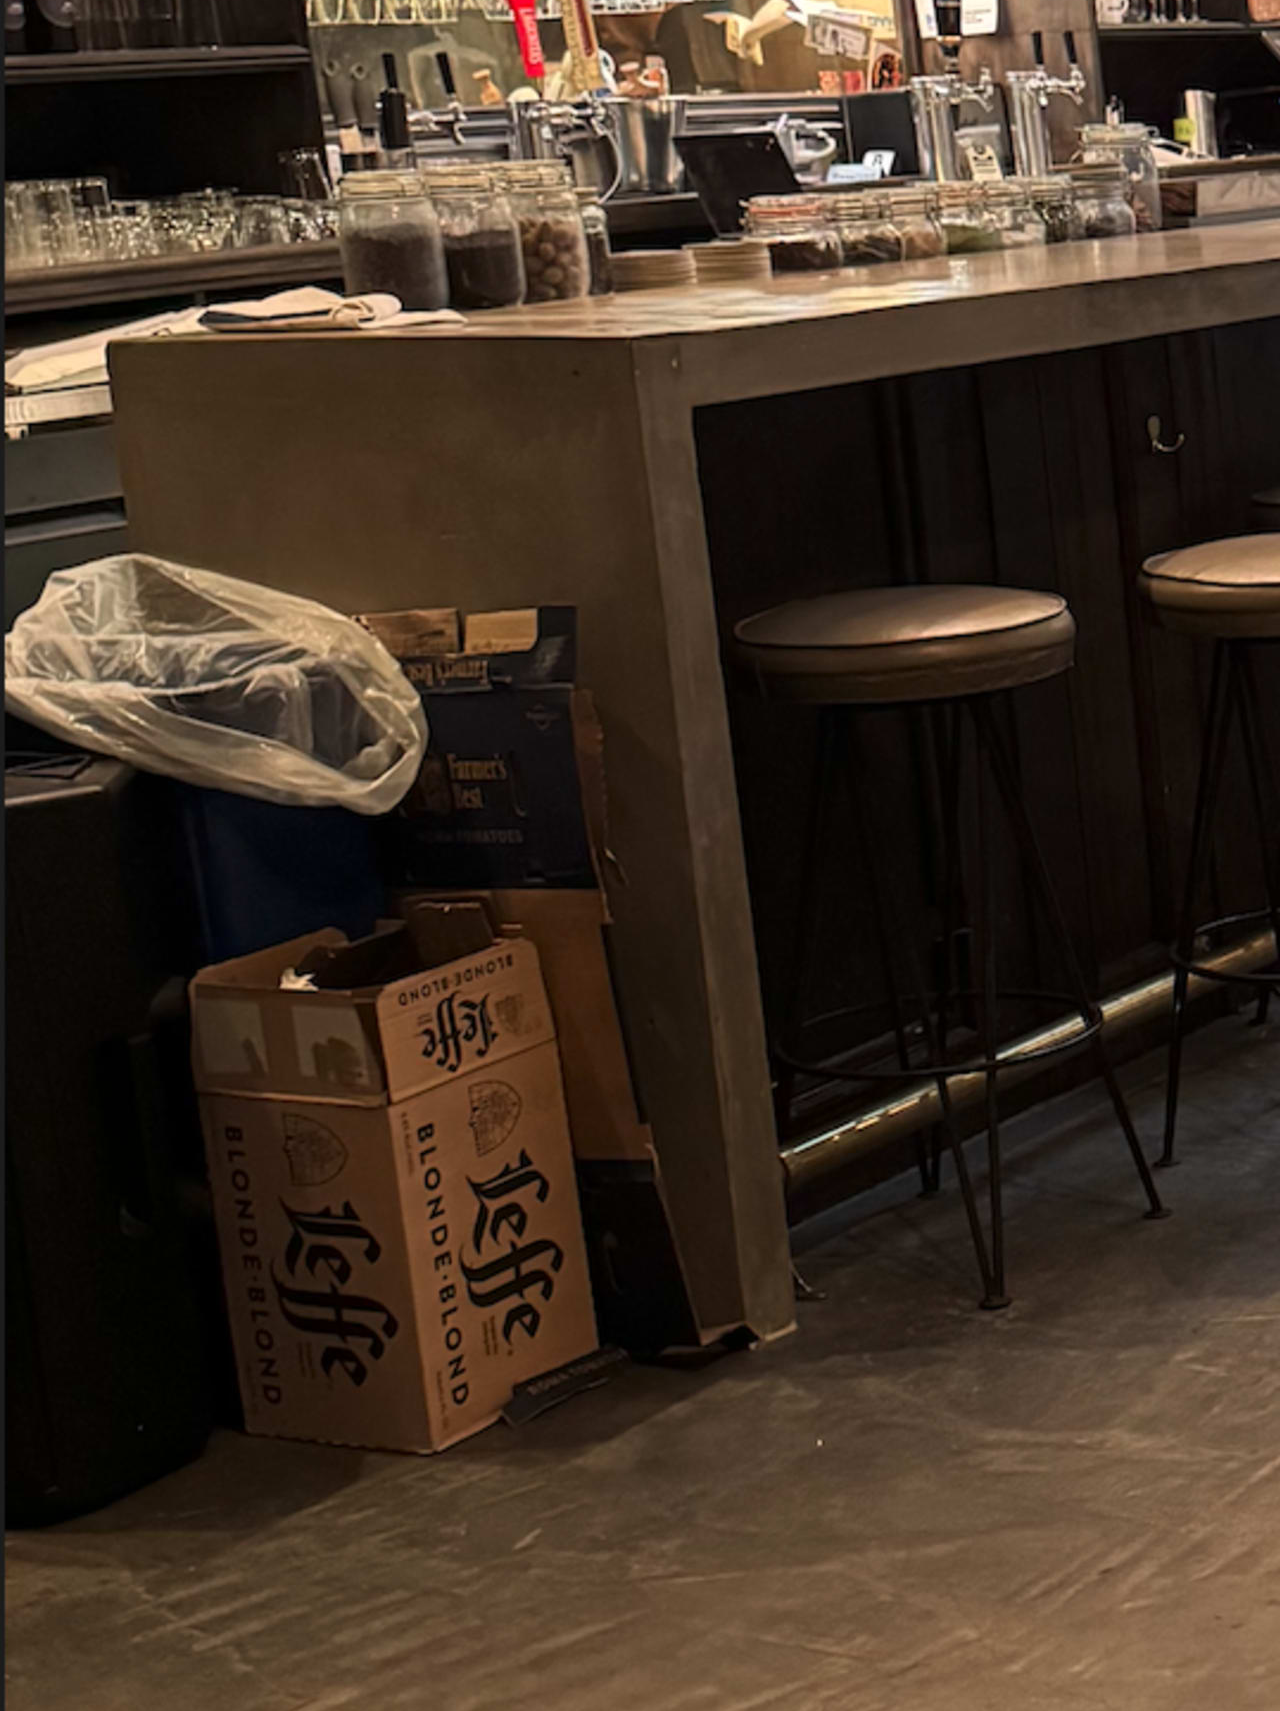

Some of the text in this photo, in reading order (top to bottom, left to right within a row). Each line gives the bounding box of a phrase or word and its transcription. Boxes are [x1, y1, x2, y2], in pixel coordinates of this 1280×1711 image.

[446, 753, 508, 781] Farmer's
[452, 784, 484, 810] Best
[418, 991, 499, 1073] Leffe
[459, 1148, 565, 1345] Leffe
[269, 1195, 400, 1388] Leffe
